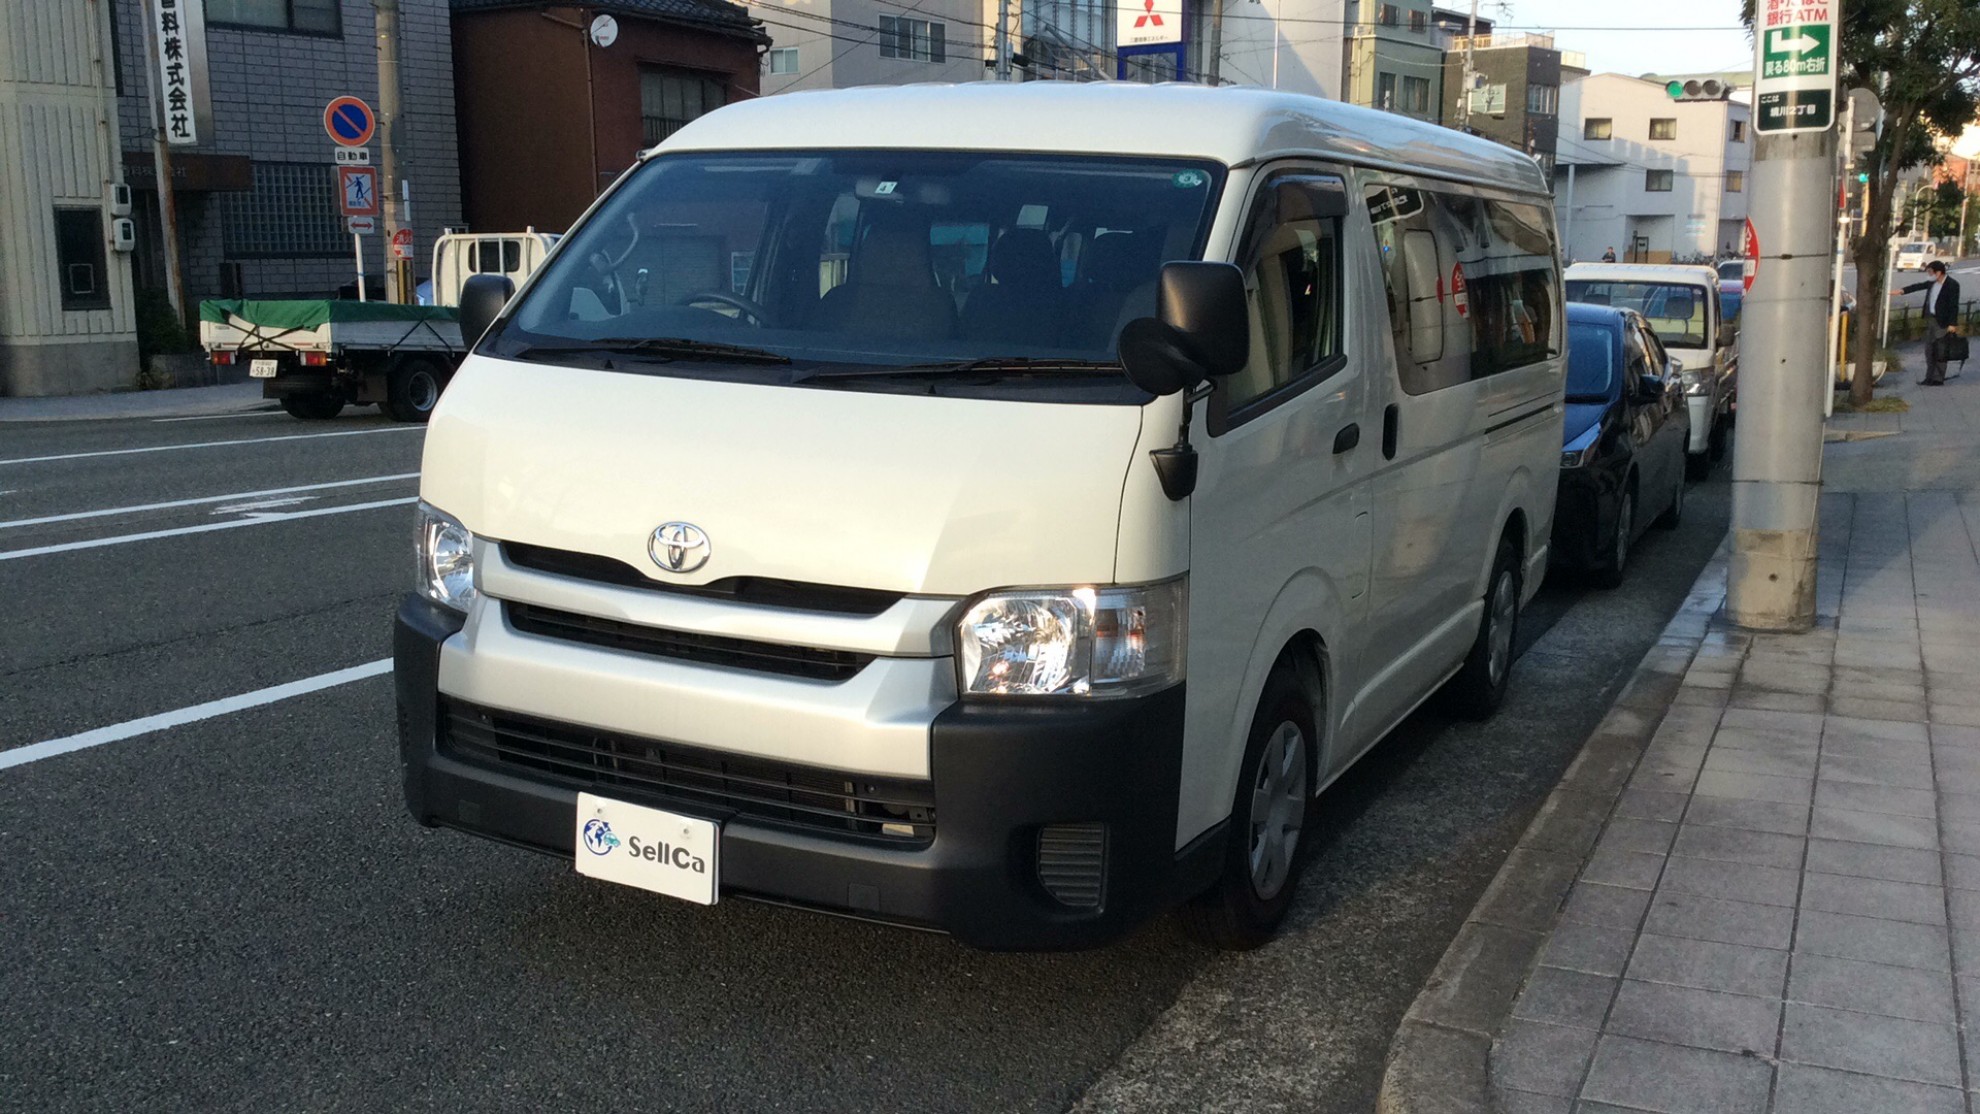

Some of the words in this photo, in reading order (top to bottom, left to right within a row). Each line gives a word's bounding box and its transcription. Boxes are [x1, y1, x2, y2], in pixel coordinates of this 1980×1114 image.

[1766, 8, 1828, 26] 銀行ATM
[337, 151, 368, 160] 自動車
[628, 835, 705, 874] SellCa
